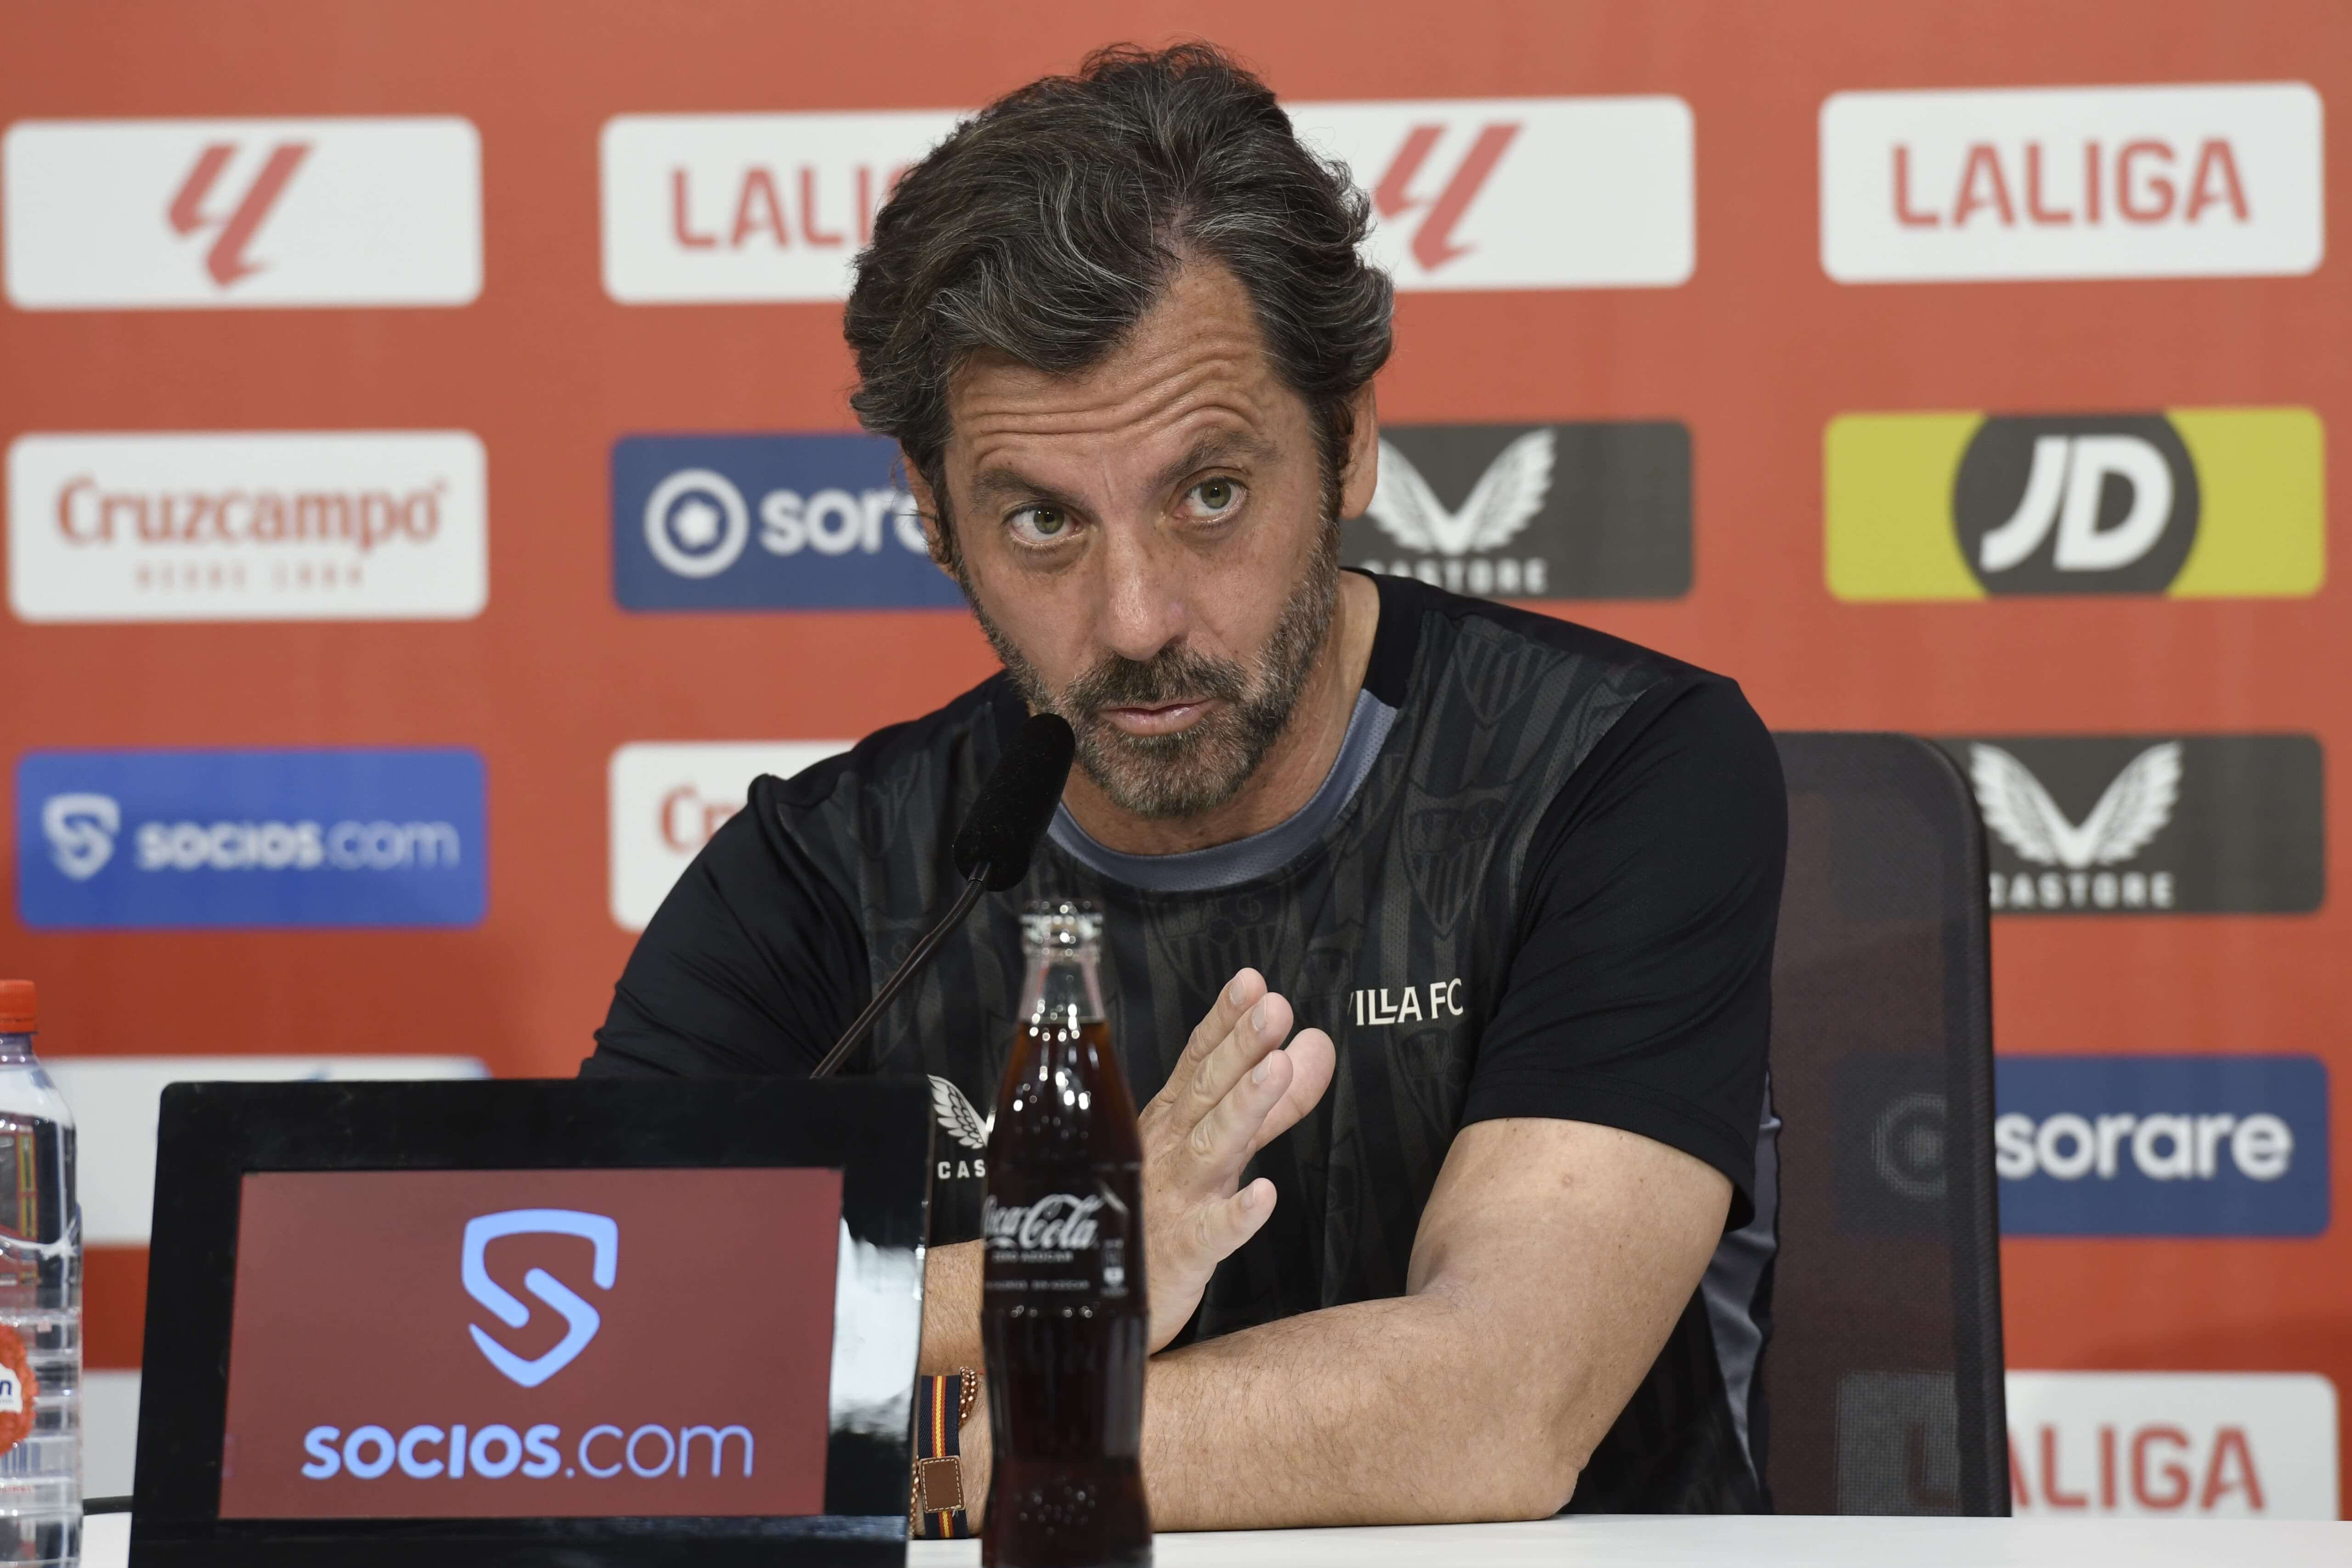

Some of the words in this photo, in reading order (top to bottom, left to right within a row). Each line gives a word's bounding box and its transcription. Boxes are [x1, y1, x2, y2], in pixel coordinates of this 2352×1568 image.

[669, 166, 907, 250] LALI
[1890, 136, 2250, 229] LALIGA
[54, 475, 441, 556] Cruzcampo
[1979, 434, 2174, 572] JD
[1348, 986, 1423, 1026] ILLA
[1430, 977, 1464, 1019] FC
[1995, 1112, 2294, 1180] sorare
